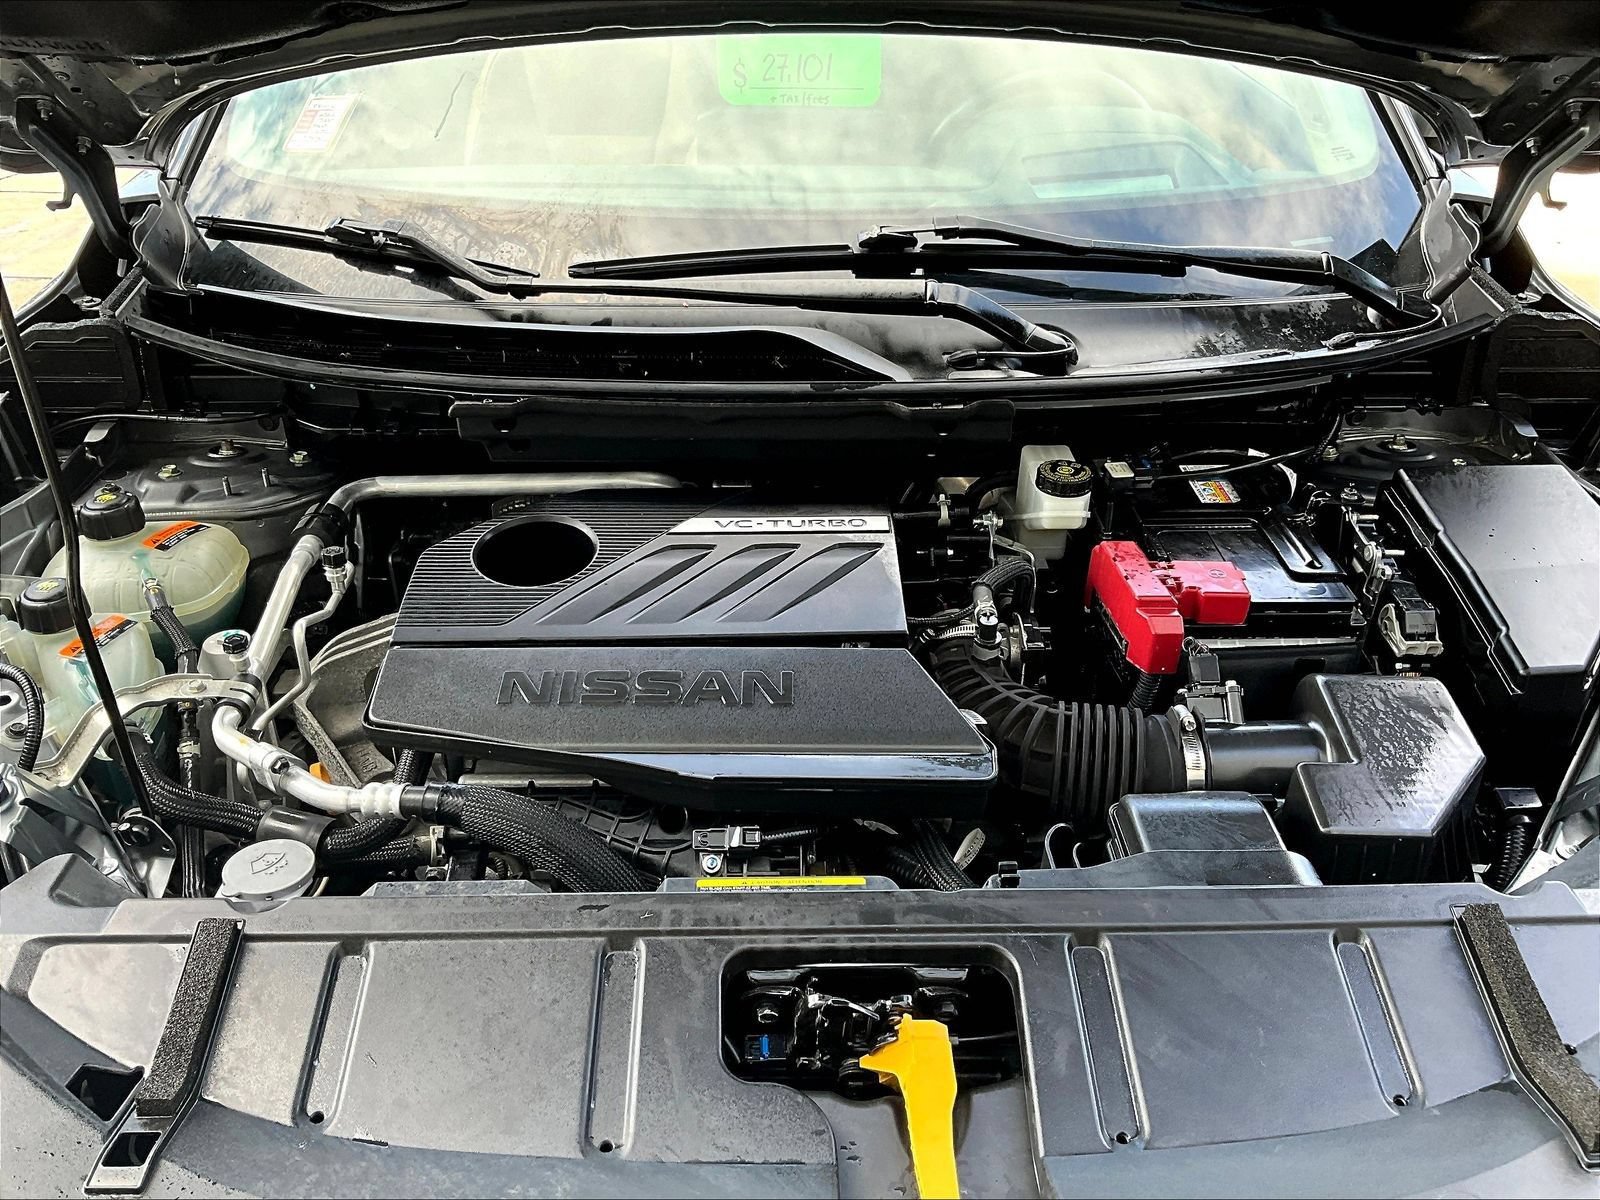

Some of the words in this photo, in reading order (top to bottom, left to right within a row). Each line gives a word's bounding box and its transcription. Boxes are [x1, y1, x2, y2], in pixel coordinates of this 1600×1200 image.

[733, 57, 747, 96] $
[714, 517, 867, 528] VC-TURBO
[495, 669, 795, 705] NISSAN
